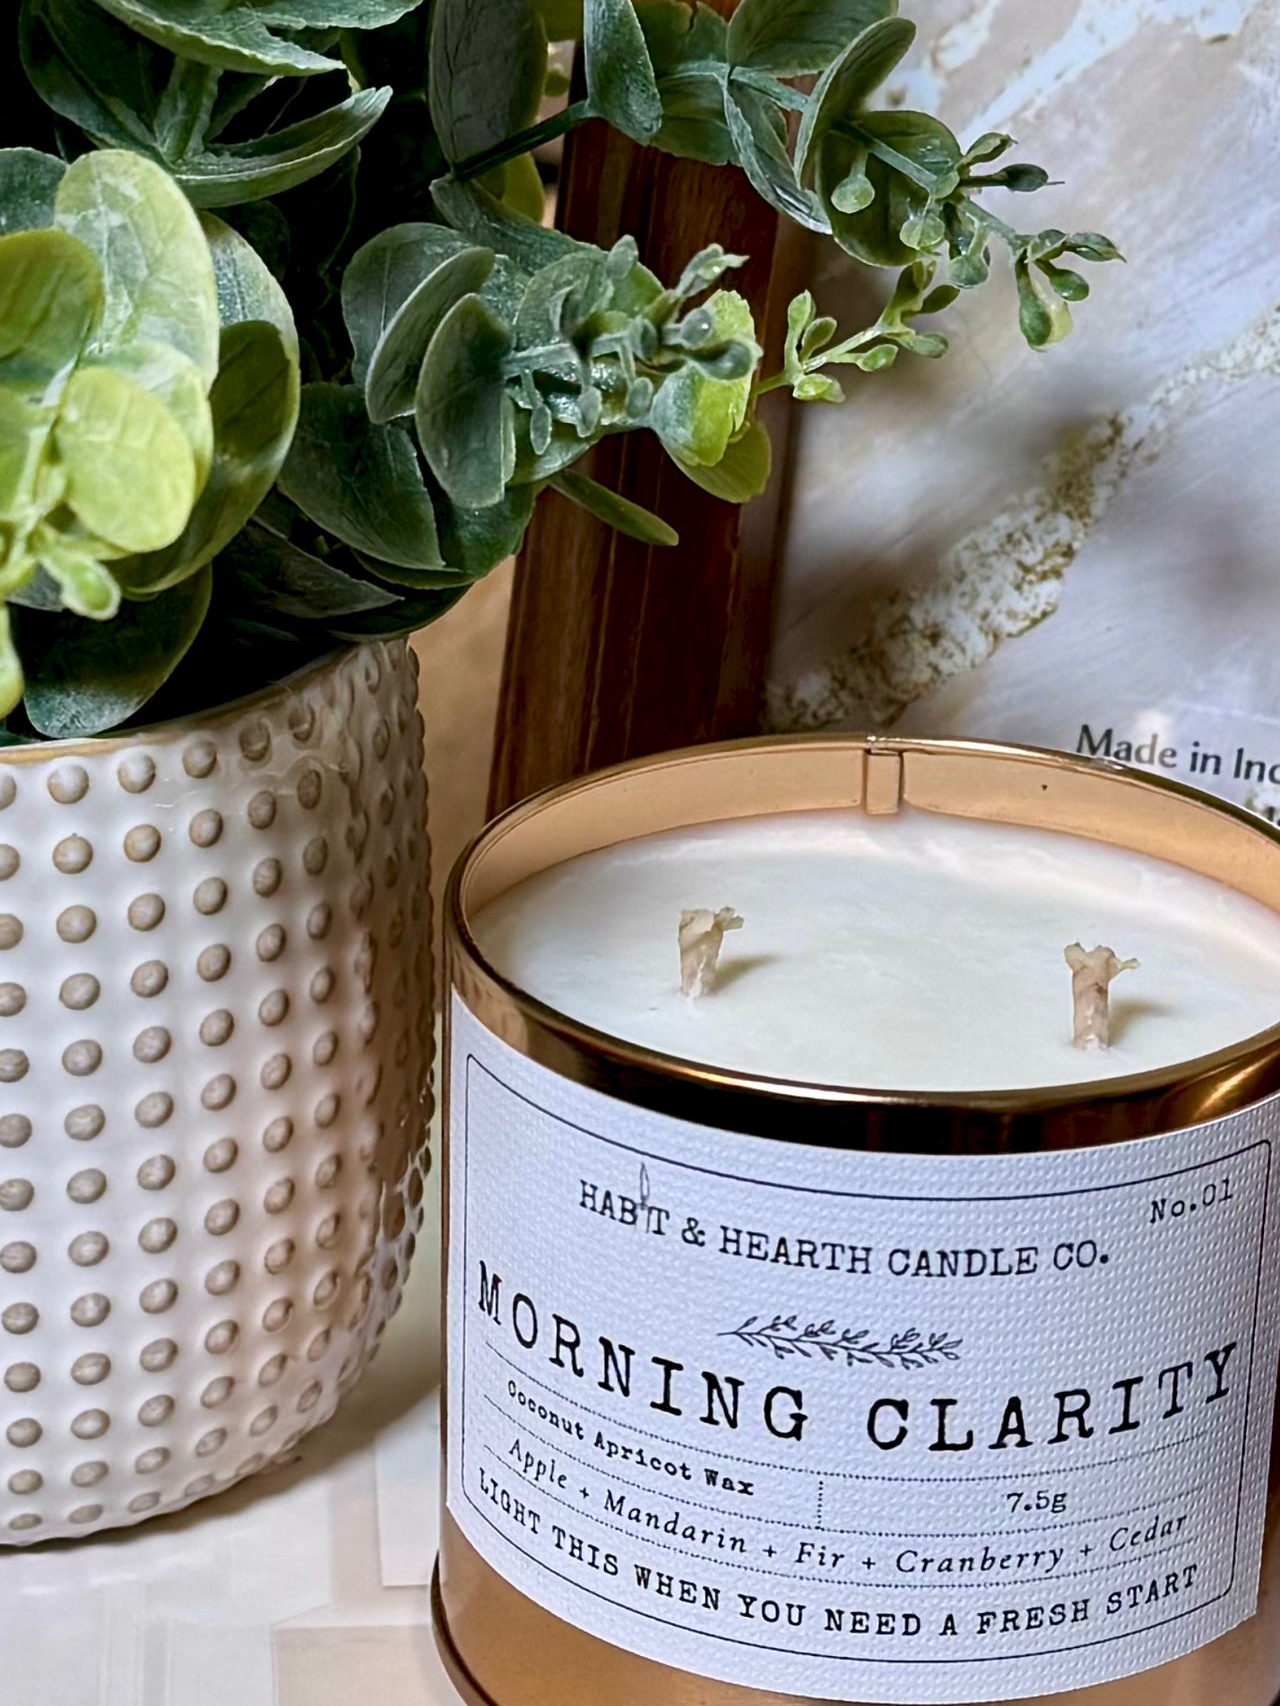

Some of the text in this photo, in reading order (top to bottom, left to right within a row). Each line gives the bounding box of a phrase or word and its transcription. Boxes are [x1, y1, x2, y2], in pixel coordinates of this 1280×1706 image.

[1076, 723, 1178, 769] Made
[1189, 740, 1222, 776] in
[1148, 1178, 1234, 1224] No.01
[680, 1216, 707, 1248] &
[719, 1224, 873, 1275] HEARTH
[887, 1246, 1039, 1278] CANDLE
[1052, 1239, 1110, 1271] CO.
[478, 1259, 1238, 1452] MORNING CLARITY
[507, 1379, 755, 1496] Coconut Apricot Wax
[508, 1438, 568, 1489] Apple
[603, 1489, 747, 1554] Mandarin
[794, 1541, 846, 1569] Fir
[895, 1545, 1065, 1574] Cranberry
[1108, 1513, 1188, 1553] Cedar
[1006, 1489, 1068, 1514] 7.5g
[479, 1466, 1199, 1637] LIGHT THIS WHEN YOU NEED A FRESH START
